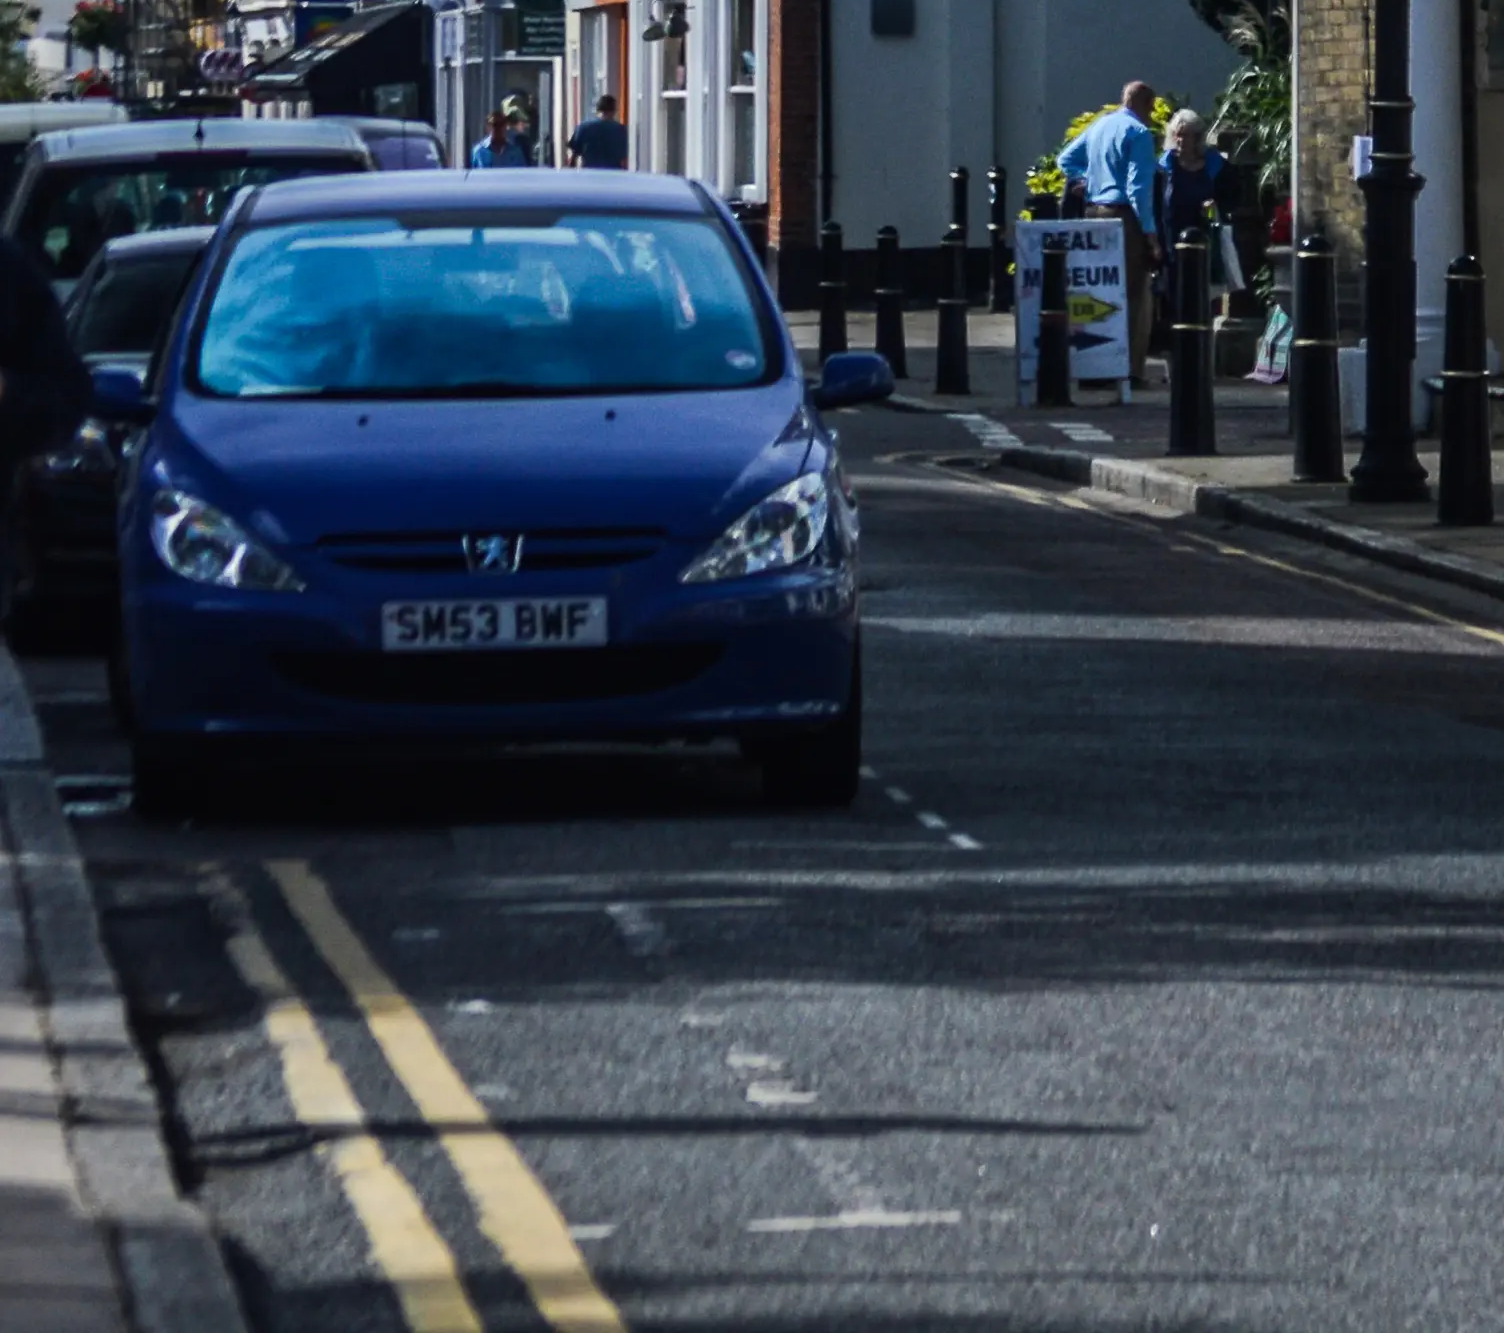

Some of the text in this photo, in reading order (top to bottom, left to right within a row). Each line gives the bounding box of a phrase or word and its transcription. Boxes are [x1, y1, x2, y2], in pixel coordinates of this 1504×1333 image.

[1023, 265, 1119, 286] MEUM
[397, 602, 591, 643] SM53 BWF
